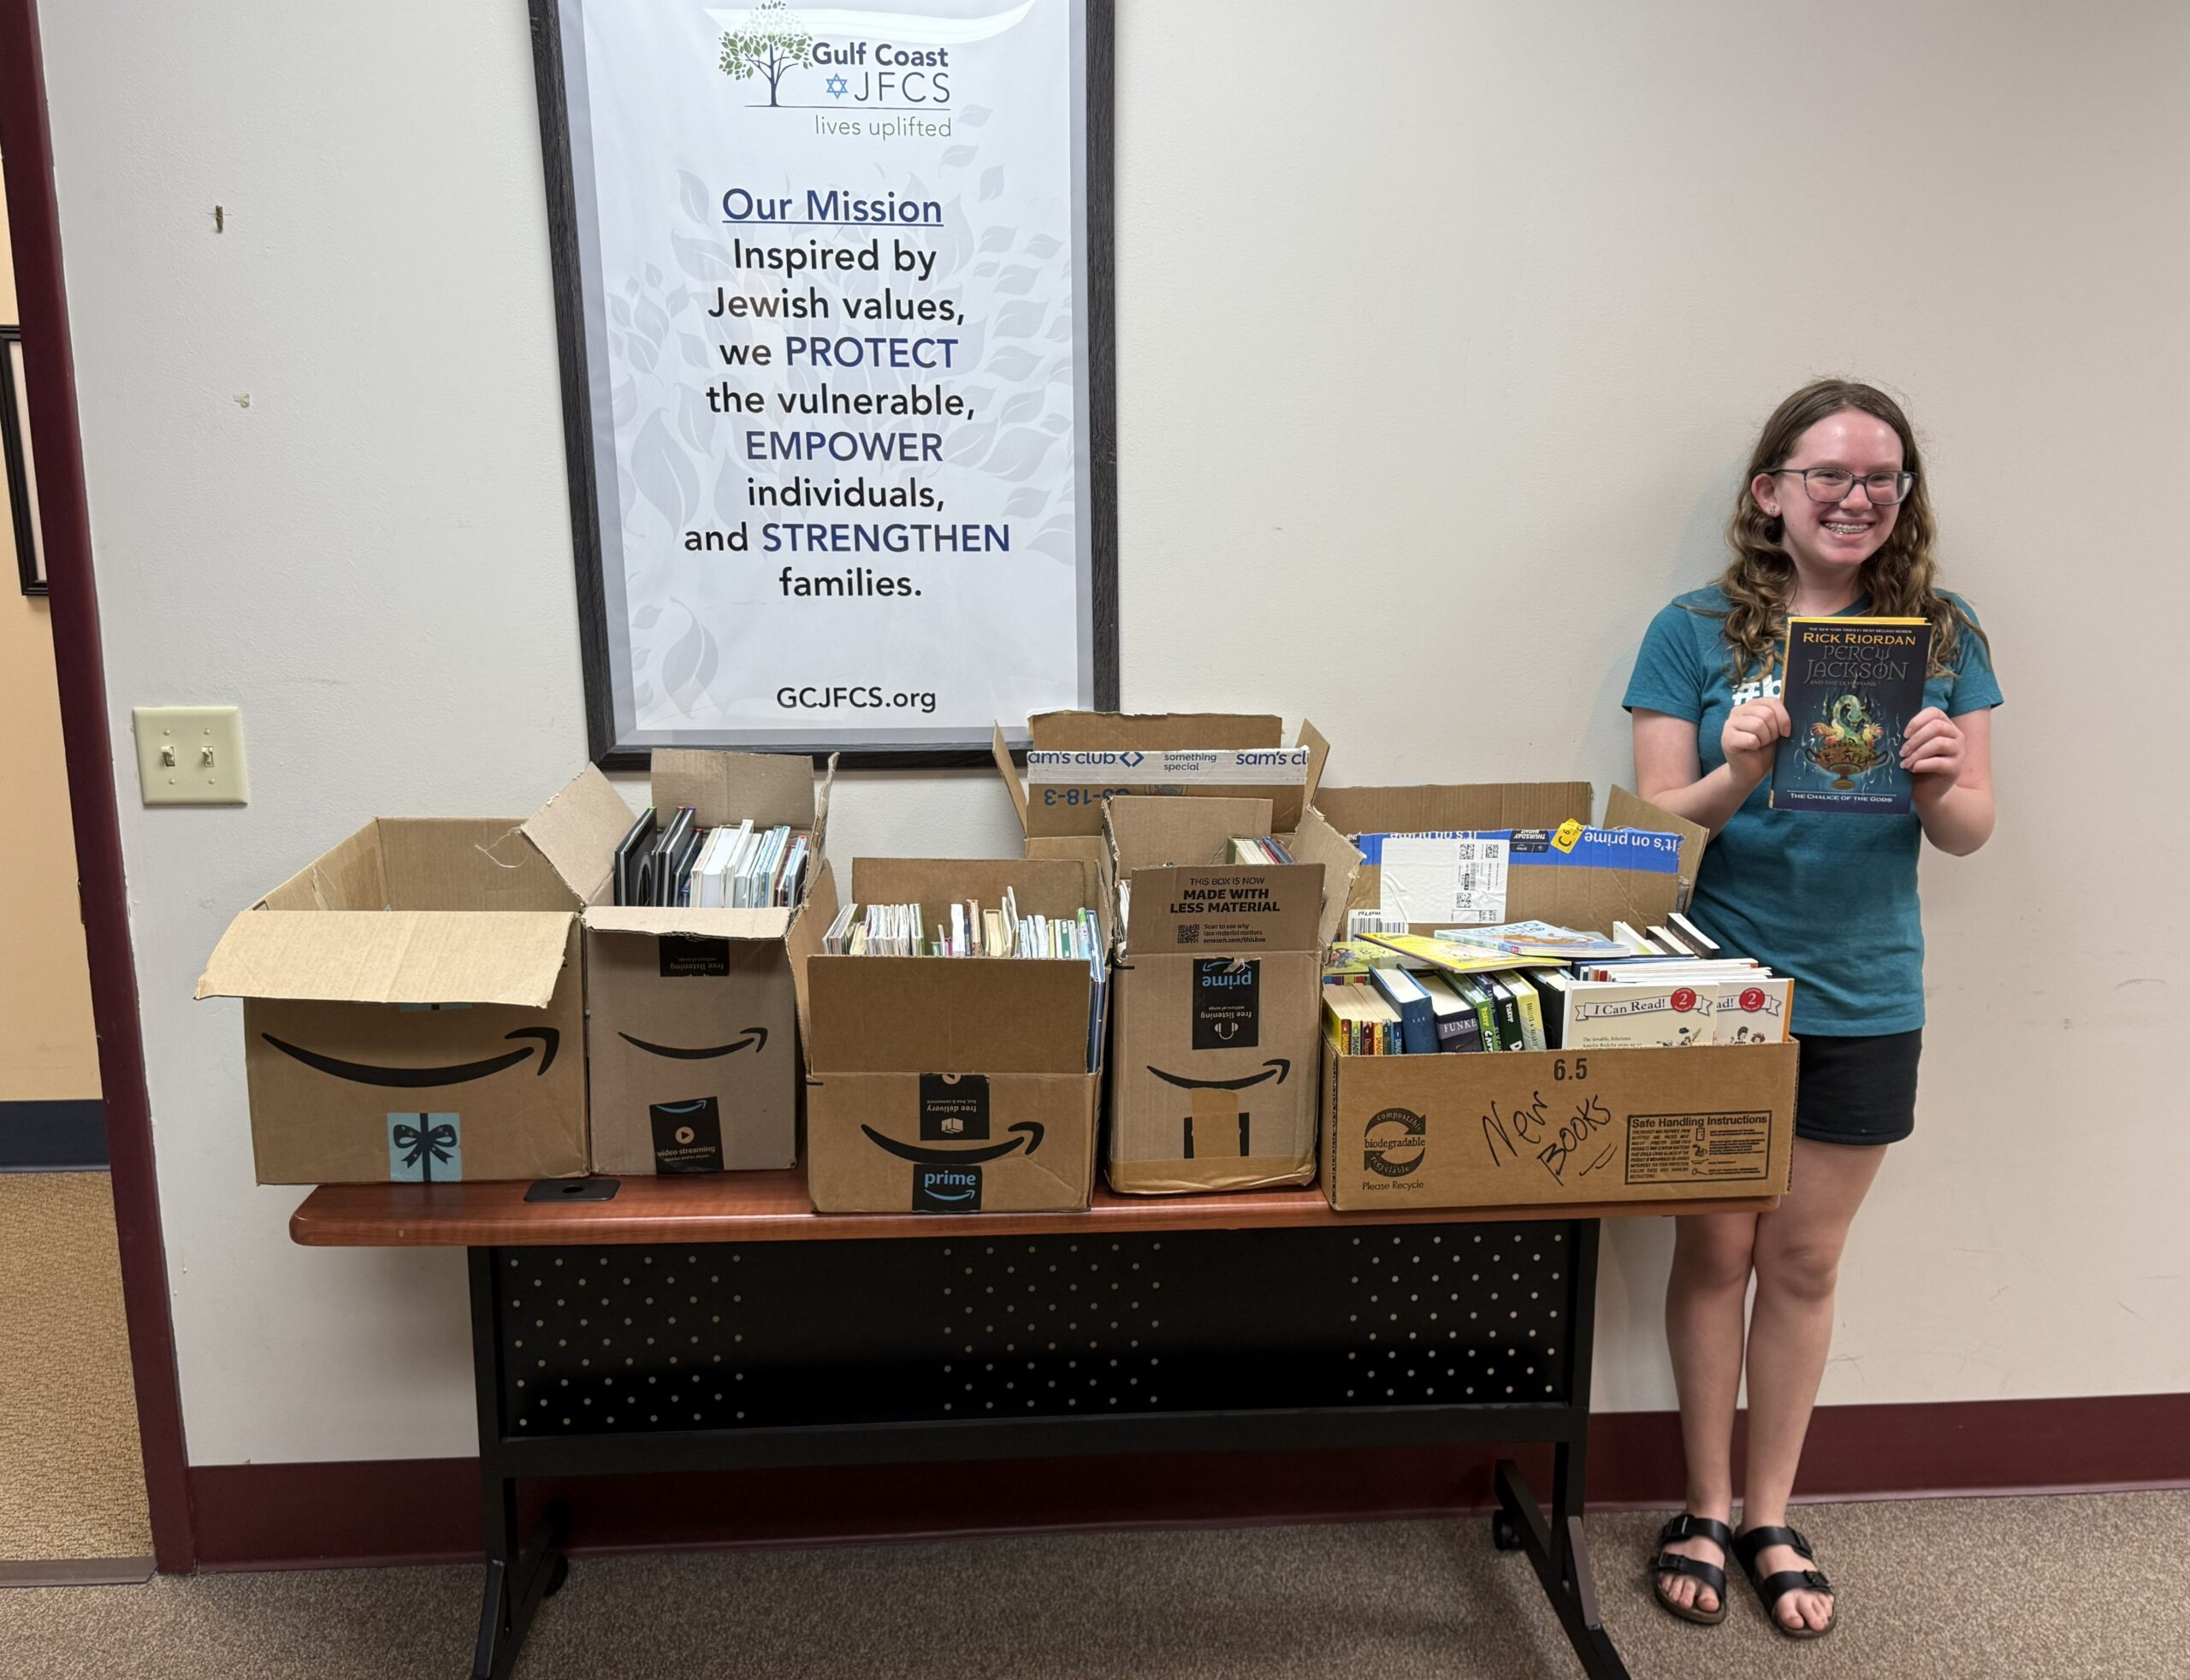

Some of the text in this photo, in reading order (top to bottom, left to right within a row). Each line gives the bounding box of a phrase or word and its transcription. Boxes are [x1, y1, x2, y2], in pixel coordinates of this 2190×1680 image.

[812, 42, 949, 68] Gulf Coast
[854, 72, 950, 104] JFCS
[814, 115, 952, 140] lives uplifted
[722, 188, 943, 224] Our Mission
[734, 240, 938, 281] Inspired by
[707, 287, 965, 327] Jewish values,
[719, 338, 959, 370] we PROTECT
[706, 382, 975, 421] the vulnerable,
[746, 430, 944, 462] EMPOWER
[747, 476, 944, 513] individuals,
[684, 524, 1010, 553] and STRENGTHEN
[779, 567, 922, 598] families.
[1803, 632, 1916, 646] RICK RIORDAN
[1823, 645, 1891, 662] PERCY
[1803, 660, 1909, 684] JACKSON
[776, 687, 937, 713] GCJFCS.org
[1074, 752, 1116, 765] club
[1164, 753, 1216, 762] something
[1236, 751, 1287, 766] sam's
[1163, 762, 1199, 772] special
[1584, 832, 1677, 852] It's on prime
[1232, 877, 1240, 885] IS
[1183, 889, 1270, 900] MADE WITH
[1170, 902, 1281, 914] LESS MATERIAL
[1202, 971, 1252, 990] prime
[1594, 1004, 1600, 1015] I
[1602, 1004, 1627, 1015] Can
[1631, 998, 1666, 1012] Read!
[1678, 993, 1688, 1005] 2
[1747, 993, 1756, 1005] 2
[1443, 1019, 1478, 1034] FUNKE
[1554, 1058, 1588, 1081] 6.5
[926, 1104, 959, 1113] delivery
[1376, 1110, 1423, 1132] compostable
[1632, 1115, 1767, 1128] Safe Handling Instructions
[678, 1145, 716, 1155] streaming
[1364, 1136, 1426, 1149] biodegradable
[1370, 1155, 1412, 1174] recyclable
[924, 1170, 976, 1188] prime
[1363, 1180, 1424, 1190] Please Recycle
